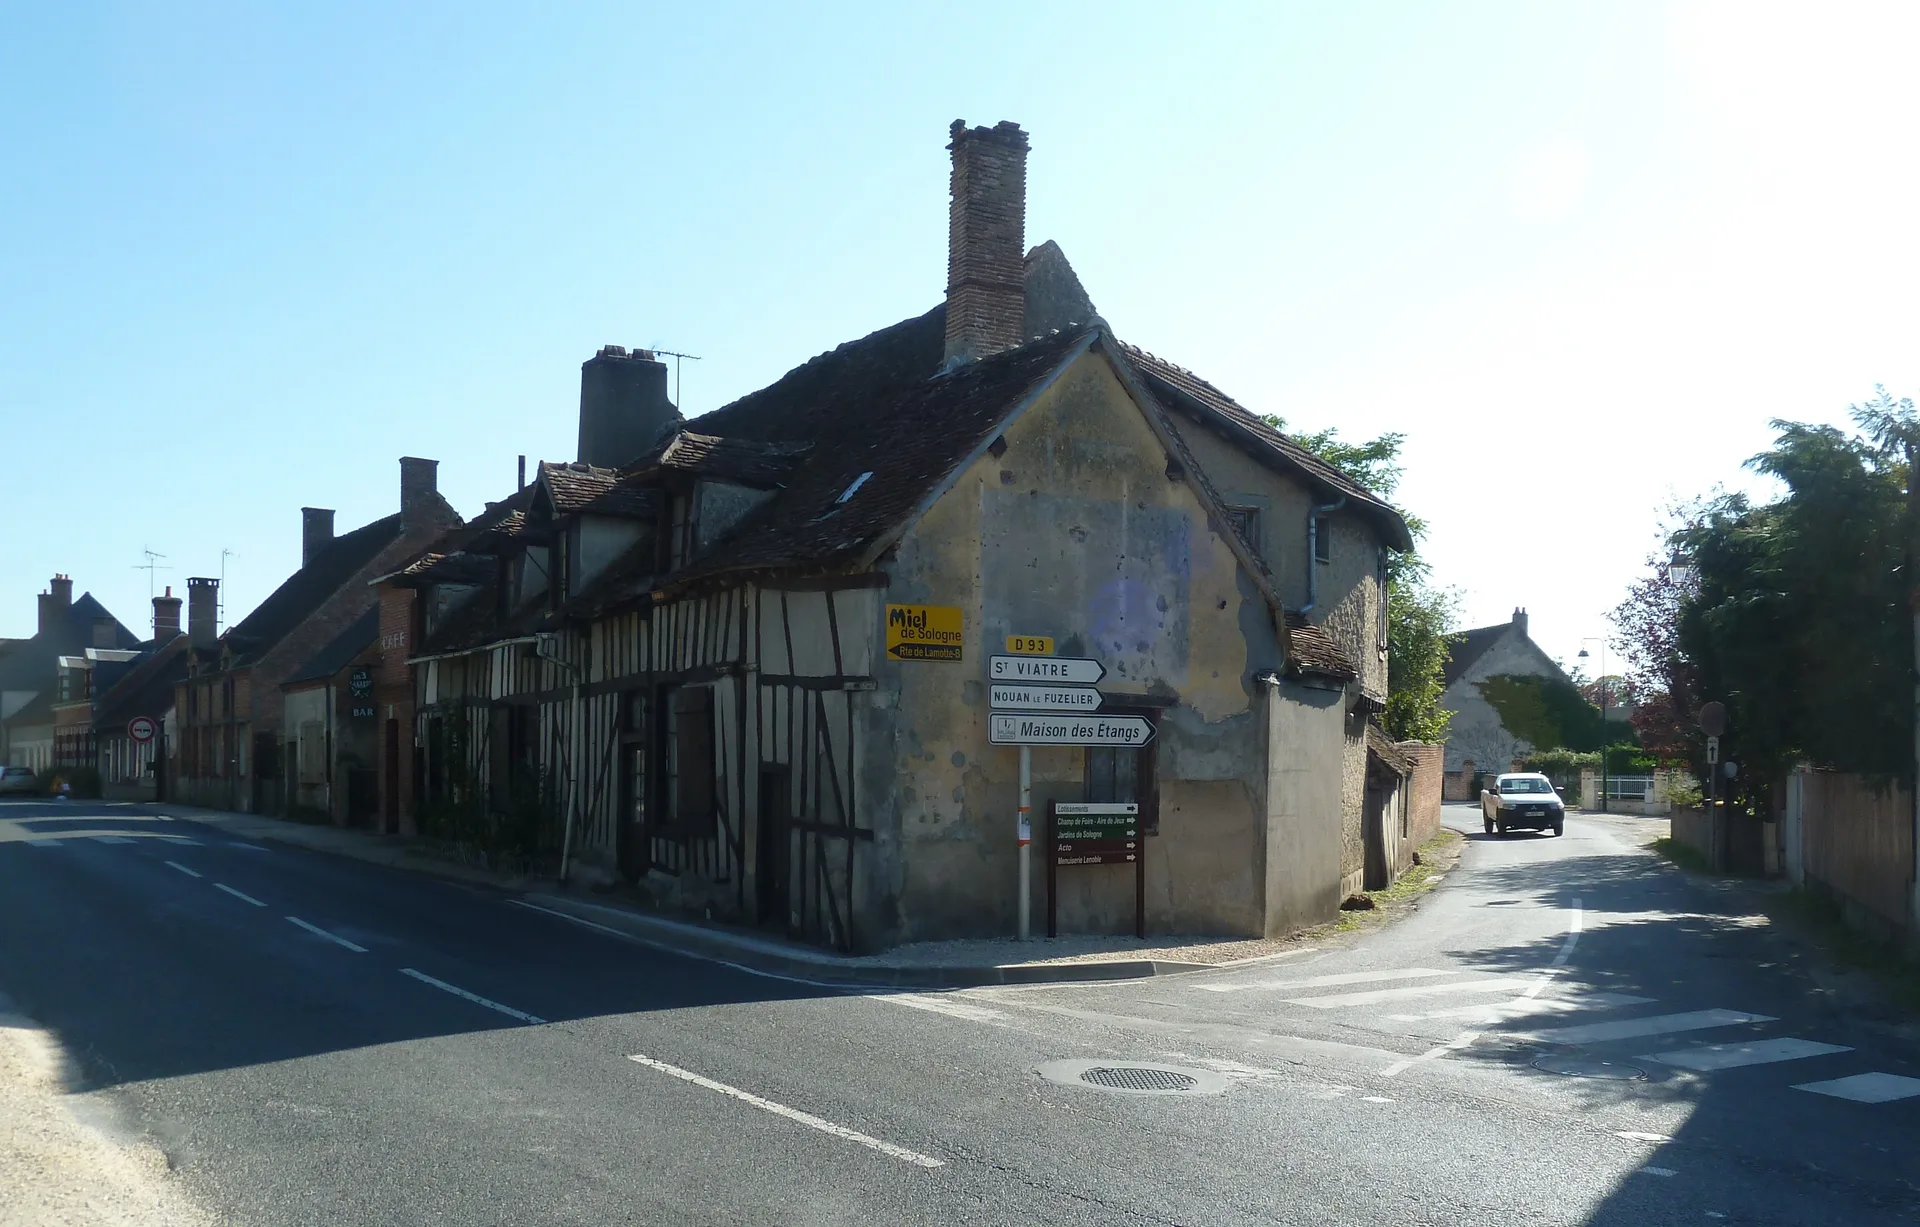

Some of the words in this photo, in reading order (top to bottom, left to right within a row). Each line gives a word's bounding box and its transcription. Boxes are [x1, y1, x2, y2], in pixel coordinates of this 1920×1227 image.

[890, 608, 926, 628] Miel
[901, 627, 914, 638] de
[918, 628, 961, 643] Sologne
[1015, 638, 1022, 651] D
[1028, 640, 1044, 651] 93
[914, 647, 923, 657] de
[1017, 663, 1068, 676] VIATRE
[994, 692, 1030, 702] NOUAN
[1044, 694, 1093, 704] FUZELIER
[353, 708, 374, 717] BAR
[1020, 722, 1067, 737] Maison
[1071, 724, 1093, 737] des
[1097, 721, 1139, 741] Étangs
[1057, 817, 1074, 826] Champ
[1075, 817, 1081, 825] de
[1097, 816, 1107, 825] Aire
[1057, 831, 1075, 839] Jardins
[1076, 830, 1082, 838] de
[1083, 830, 1102, 839] Sologne
